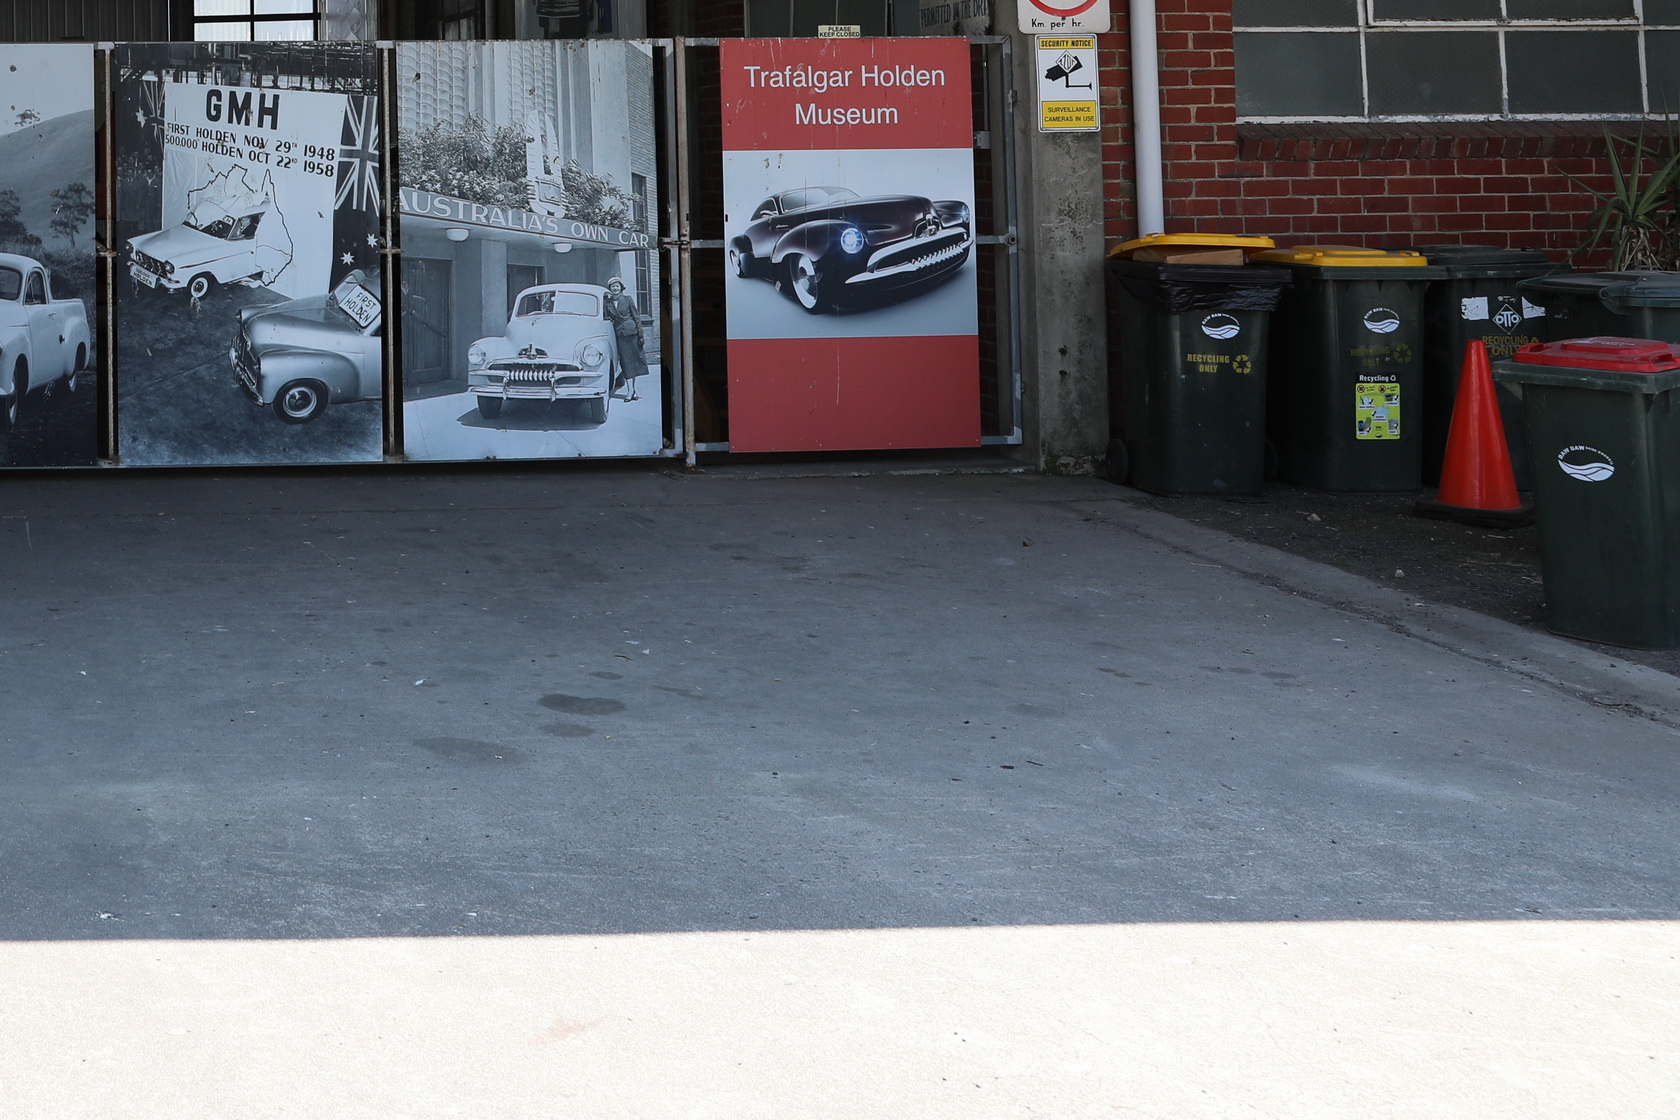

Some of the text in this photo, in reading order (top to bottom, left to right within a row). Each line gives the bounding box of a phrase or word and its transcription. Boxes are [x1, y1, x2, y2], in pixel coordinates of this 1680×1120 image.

[920, 3, 951, 28] PERMITTED
[1050, 19, 1066, 30] per
[1071, 18, 1085, 28] hr.
[1040, 39, 1092, 47] SECURITY NOTICE
[743, 64, 946, 93] Trafalgar Holden
[205, 88, 280, 131] GMH
[795, 103, 899, 125] Museum
[1047, 106, 1092, 114] SURVEILLANCE
[167, 122, 191, 136] FIRST
[196, 126, 237, 144] HOLDEN
[244, 134, 269, 149] NOV
[303, 144, 336, 162] 1948
[201, 141, 244, 159] HOLDEN
[248, 150, 271, 165] OCT
[303, 160, 335, 178] 1958
[400, 191, 649, 248] AUSTRALIA'S OWN CAR
[344, 297, 372, 323] HOLDEN
[356, 291, 376, 310] FIRST
[1495, 311, 1522, 327] OTTO
[1186, 353, 1230, 364] RECYCLING
[1199, 364, 1218, 373] ONLY
[1359, 374, 1390, 383] Recycling
